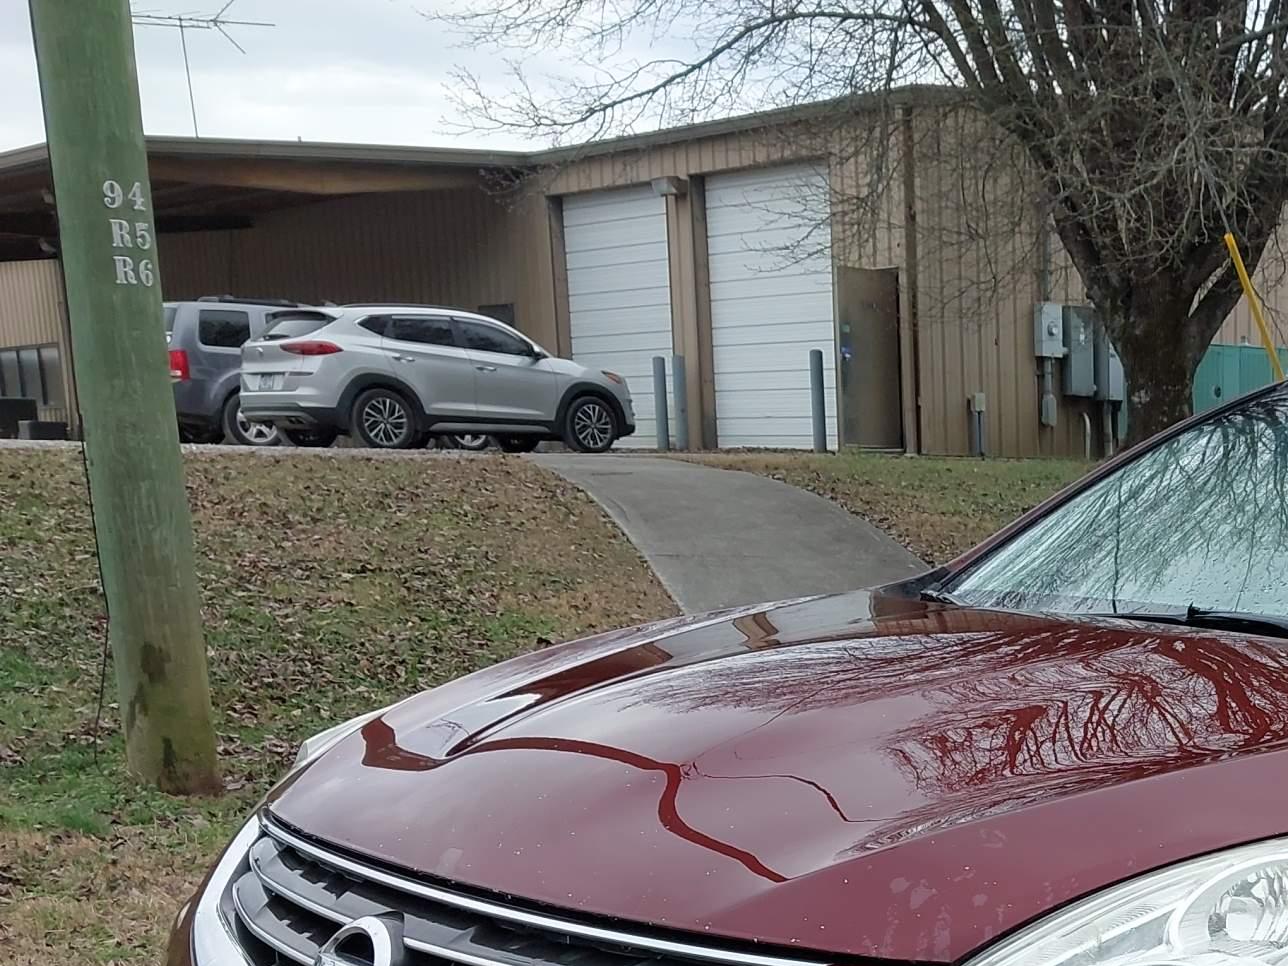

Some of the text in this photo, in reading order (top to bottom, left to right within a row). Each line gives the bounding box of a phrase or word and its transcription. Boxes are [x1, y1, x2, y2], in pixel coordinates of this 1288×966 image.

[102, 180, 146, 210] 94
[108, 218, 151, 249] R5
[112, 255, 154, 287] R6
